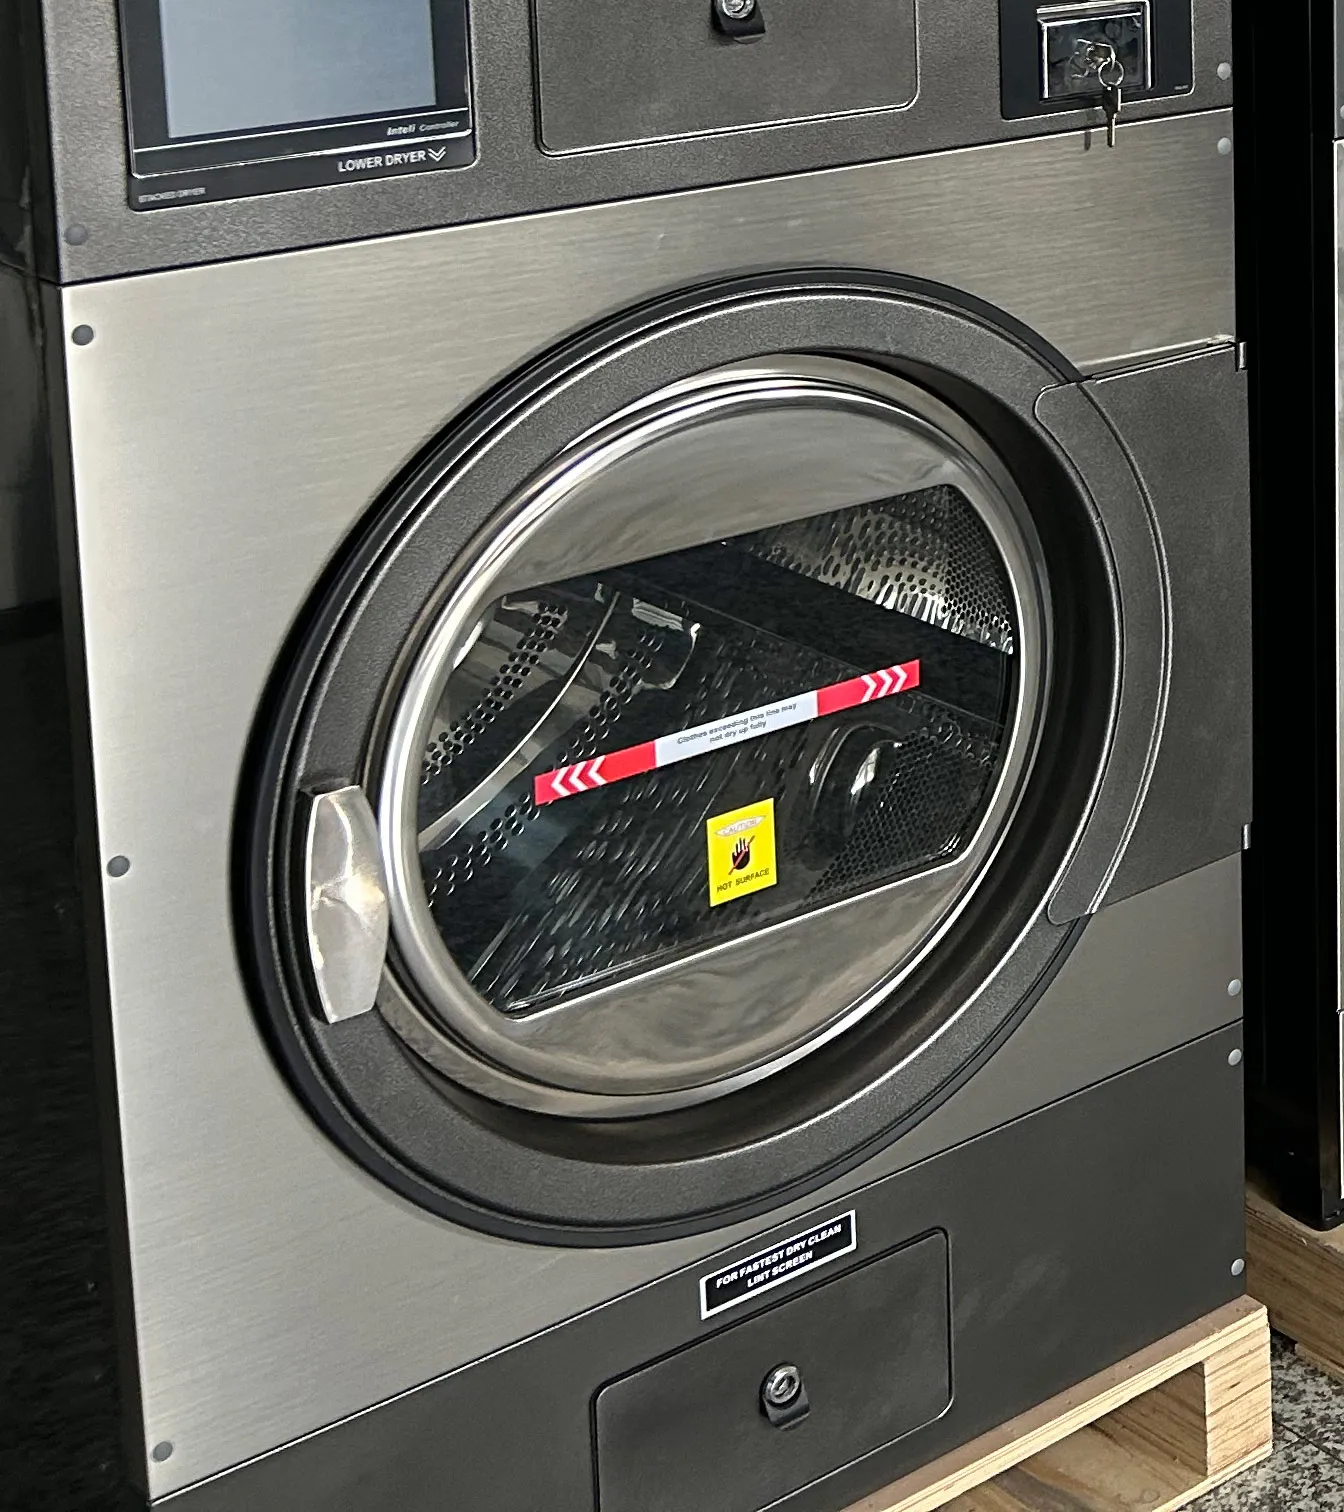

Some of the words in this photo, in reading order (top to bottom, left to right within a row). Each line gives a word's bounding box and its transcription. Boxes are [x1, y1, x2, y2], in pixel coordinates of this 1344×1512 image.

[337, 156, 382, 173] LOWER
[385, 150, 426, 166] DRYER
[677, 731, 708, 744] Clothes
[724, 730, 737, 738] dry
[717, 880, 732, 893] HOT
[735, 868, 769, 886] SURFACE
[716, 1272, 739, 1288] FOR
[739, 1249, 785, 1278] FASTEST
[786, 1240, 807, 1257] DRY
[808, 1224, 842, 1246] CLEAN
[747, 1270, 770, 1288] LINT
[772, 1250, 813, 1276] SCREEN
